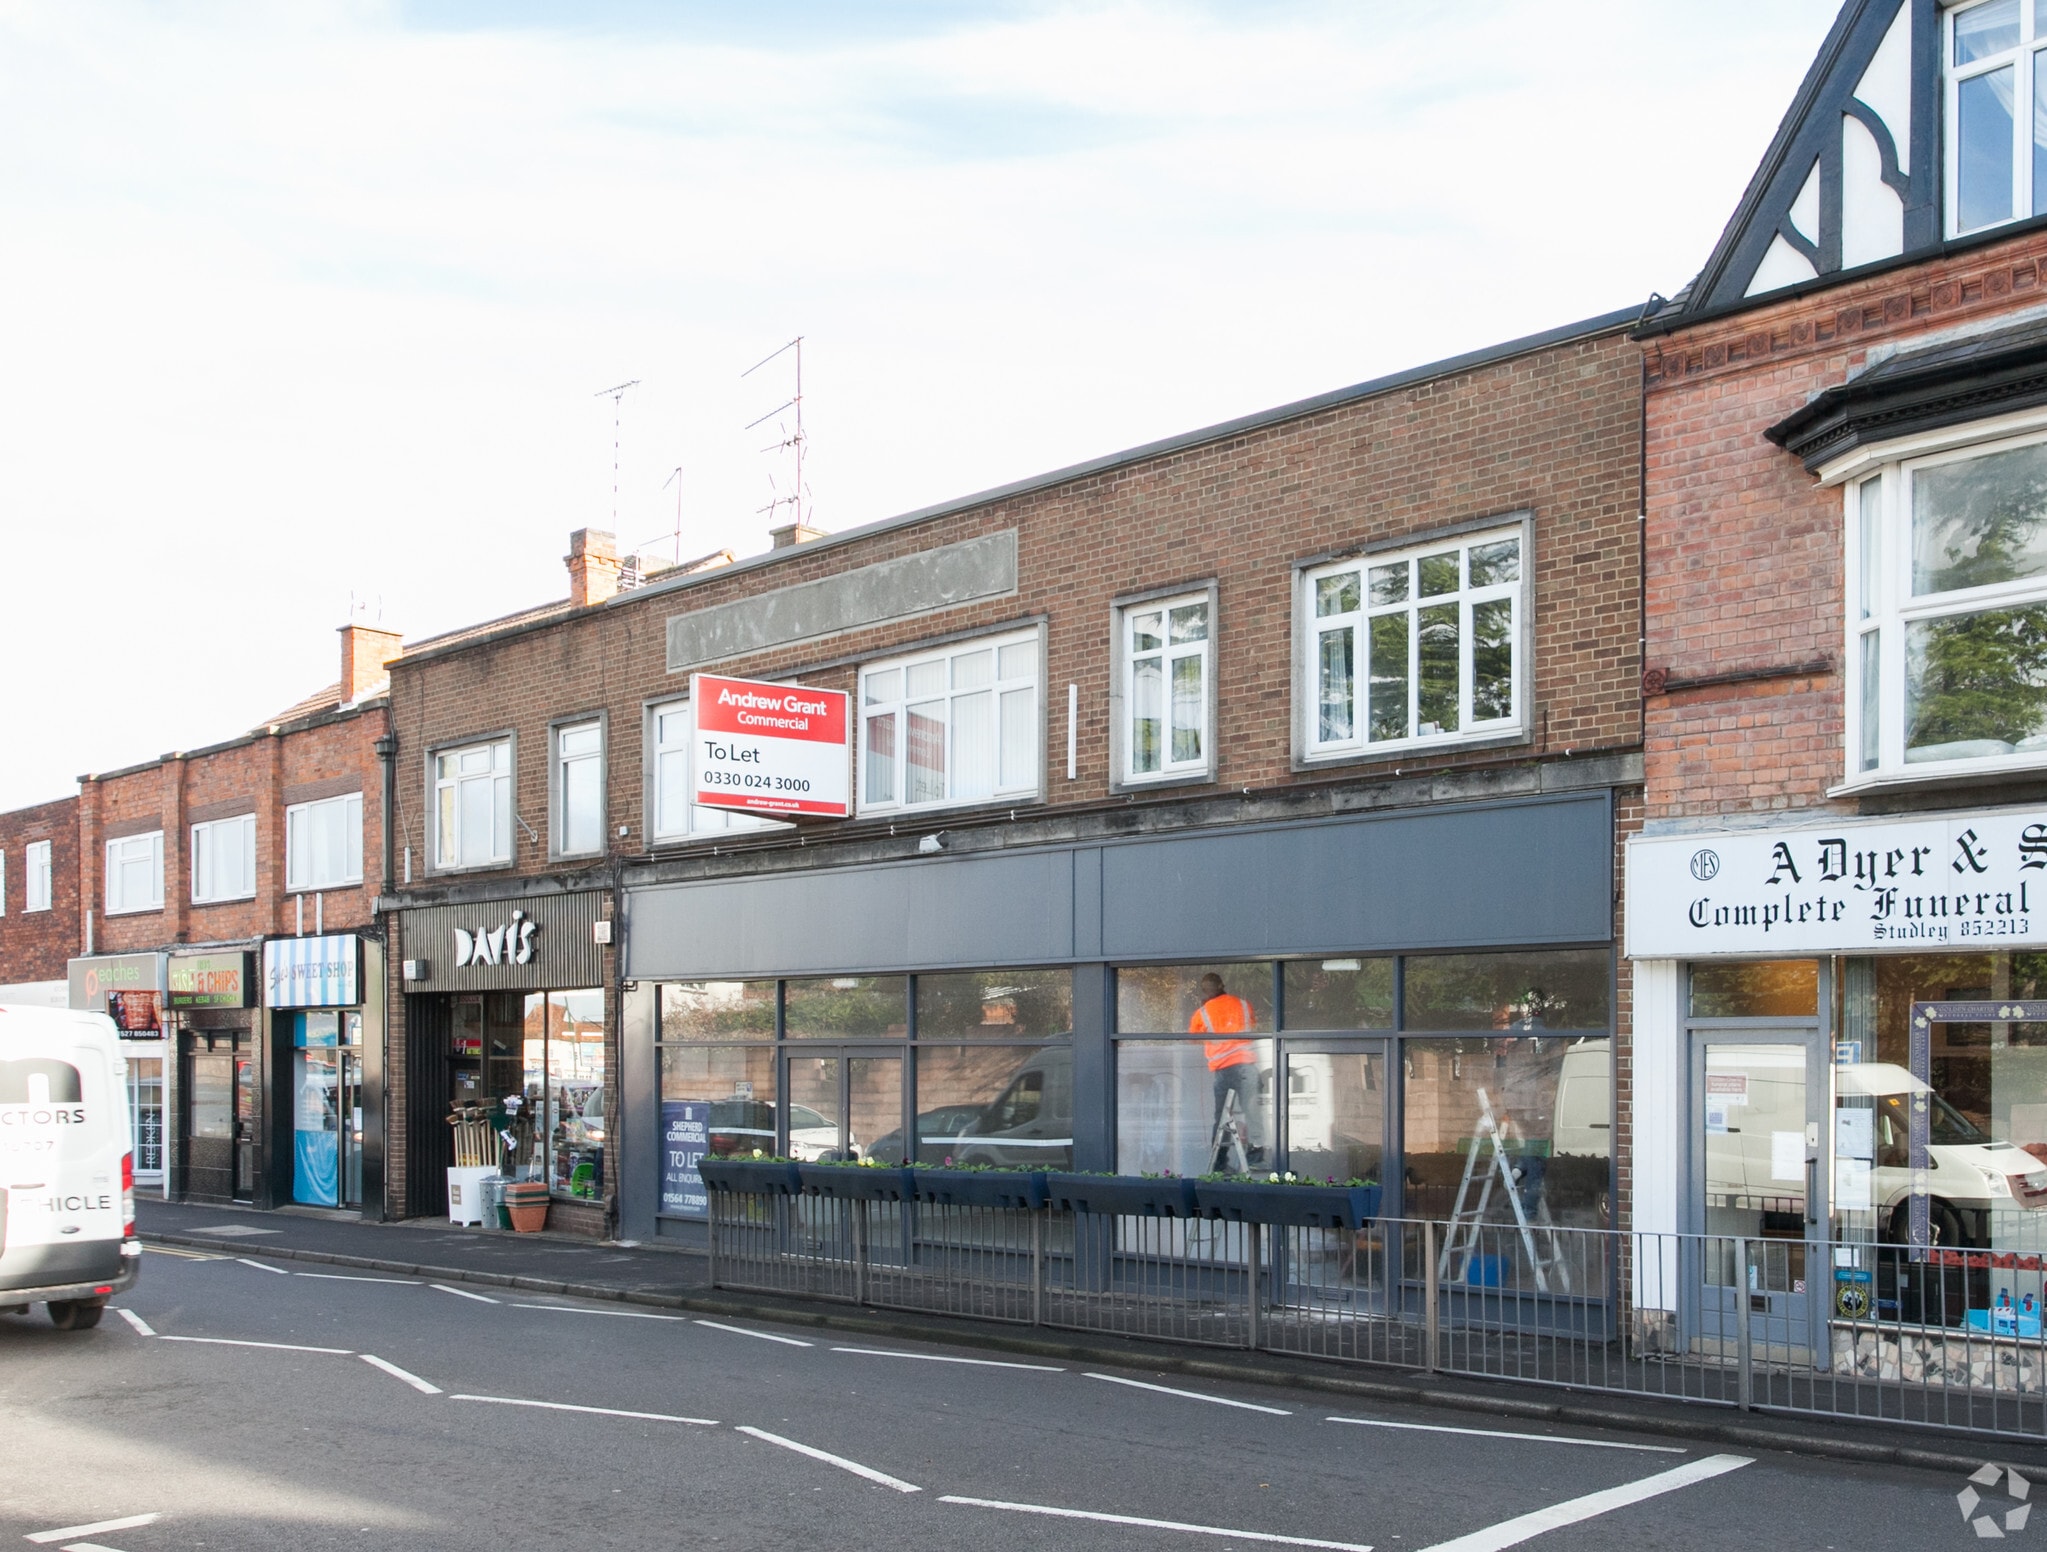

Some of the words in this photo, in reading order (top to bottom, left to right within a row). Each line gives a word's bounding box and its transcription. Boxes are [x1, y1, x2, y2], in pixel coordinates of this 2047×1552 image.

[717, 688, 782, 711] Andrew
[783, 695, 827, 717] Grant
[737, 711, 809, 731] Commercial
[704, 741, 727, 760] To
[730, 743, 760, 764] Let
[704, 770, 741, 786] 0330
[744, 774, 771, 789] 024
[775, 777, 811, 792] 3000
[746, 798, 800, 810] andrew-grant.co.uk
[1691, 849, 1718, 880] MES
[1764, 841, 1803, 885] A
[1817, 838, 1931, 891] Dyer
[1951, 828, 1989, 874] &
[1688, 892, 1846, 933] Complete
[1869, 880, 2031, 921] Funeral
[1873, 922, 1949, 942] Studley
[1960, 918, 2029, 937] 852213
[291, 962, 324, 980] SWEET
[326, 960, 354, 978] SHOP
[207, 970, 239, 993] CHIPS
[666, 1131, 707, 1143] COMMERCIAL
[672, 1120, 703, 1133] SHEPHERD
[145, 1113, 156, 1164] REDKEN
[669, 1150, 685, 1168] TO
[666, 1172, 678, 1182] ALL
[21, 1195, 112, 1212] HICLE
